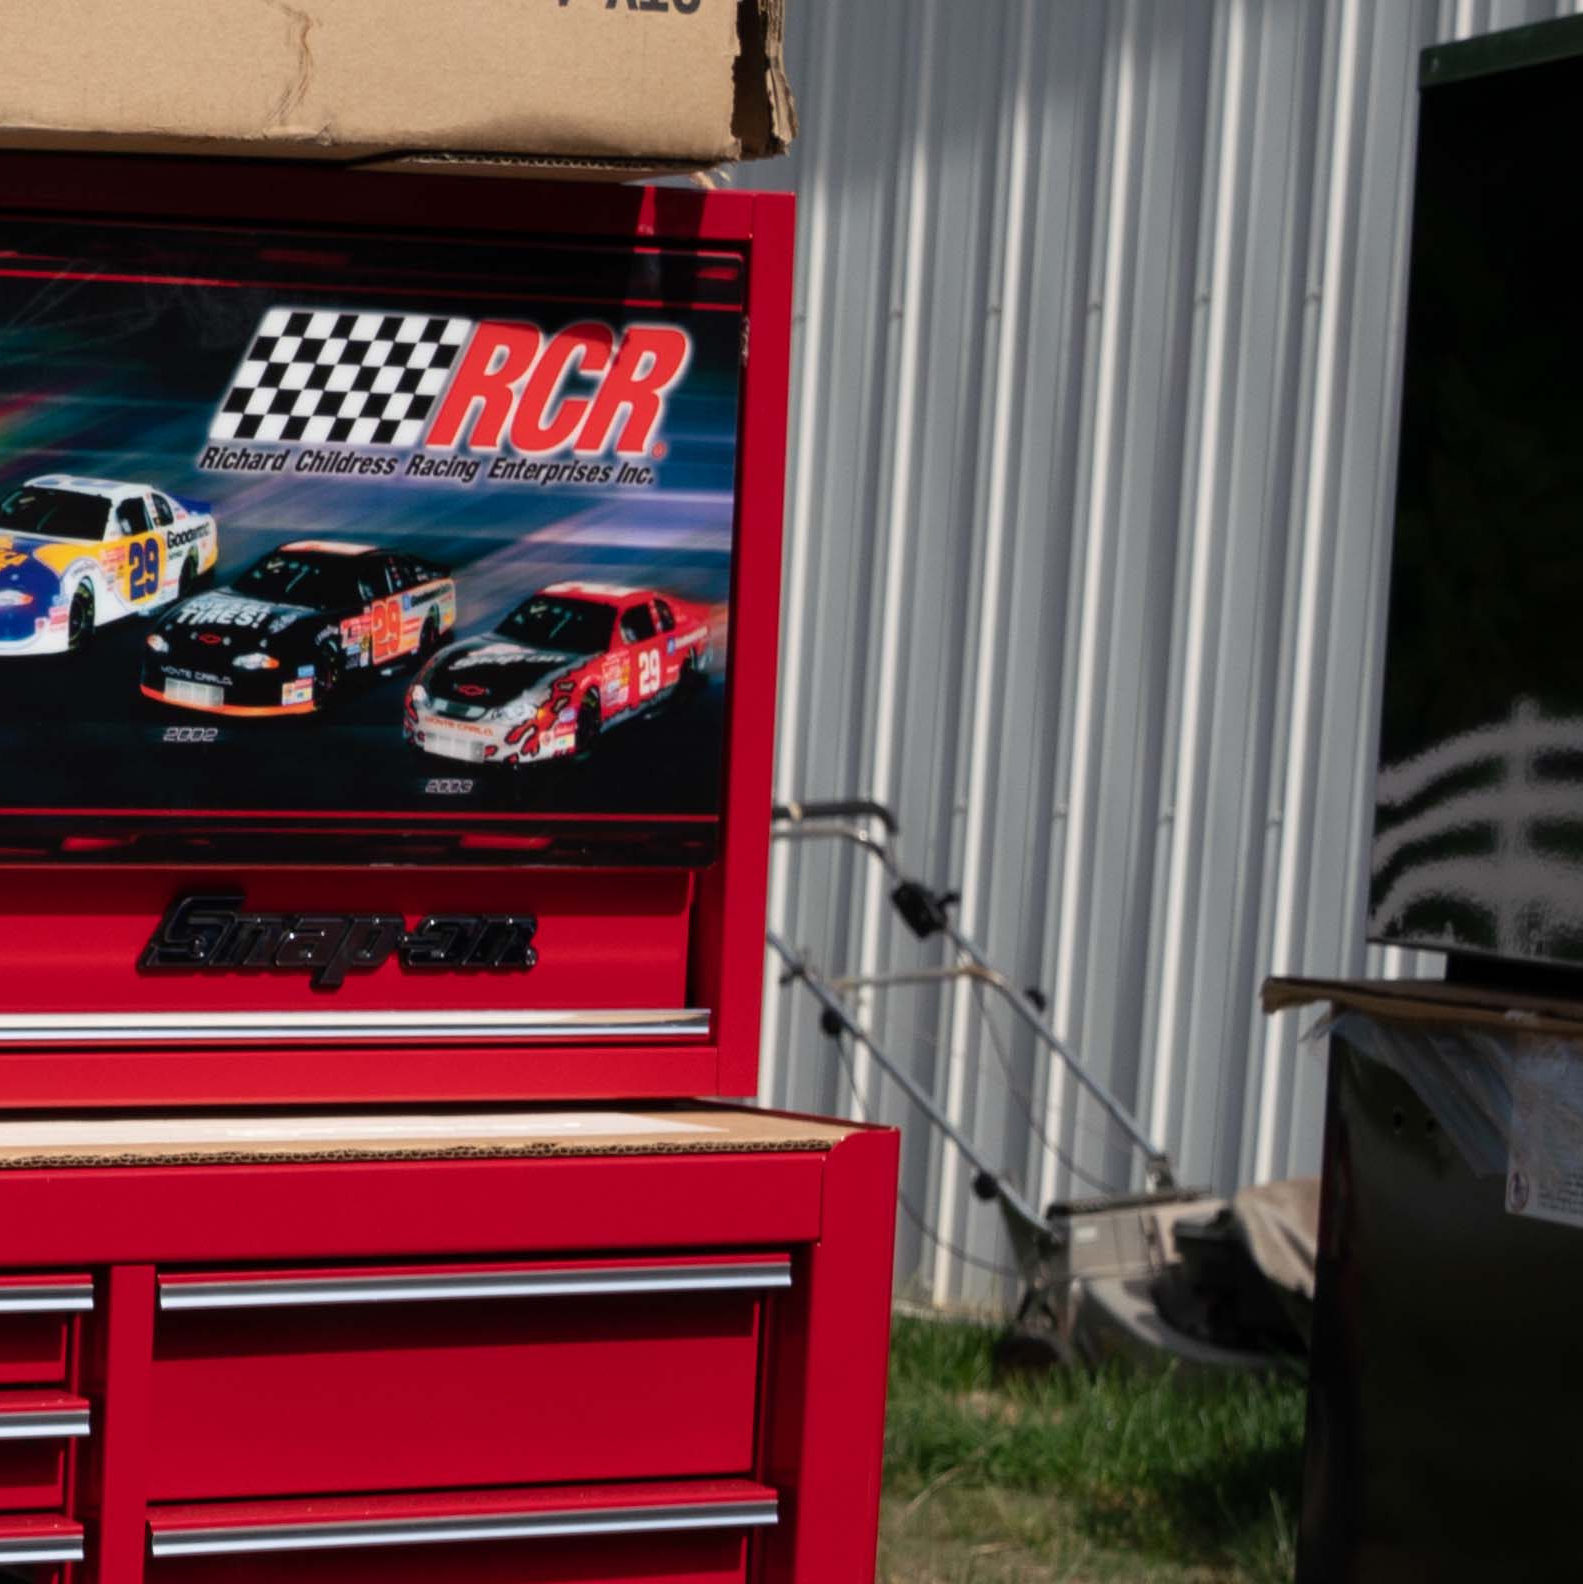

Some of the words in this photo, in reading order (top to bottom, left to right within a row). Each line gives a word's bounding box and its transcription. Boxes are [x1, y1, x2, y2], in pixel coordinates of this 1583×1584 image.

[424, 320, 688, 455] RCR
[199, 446, 290, 473] Richard
[295, 448, 399, 476] Childress
[405, 455, 482, 484] Racing
[488, 458, 613, 486] Enterprises
[616, 464, 656, 485] Inc.
[128, 537, 160, 601] 29
[637, 647, 662, 697] 29
[162, 727, 220, 743] 2002
